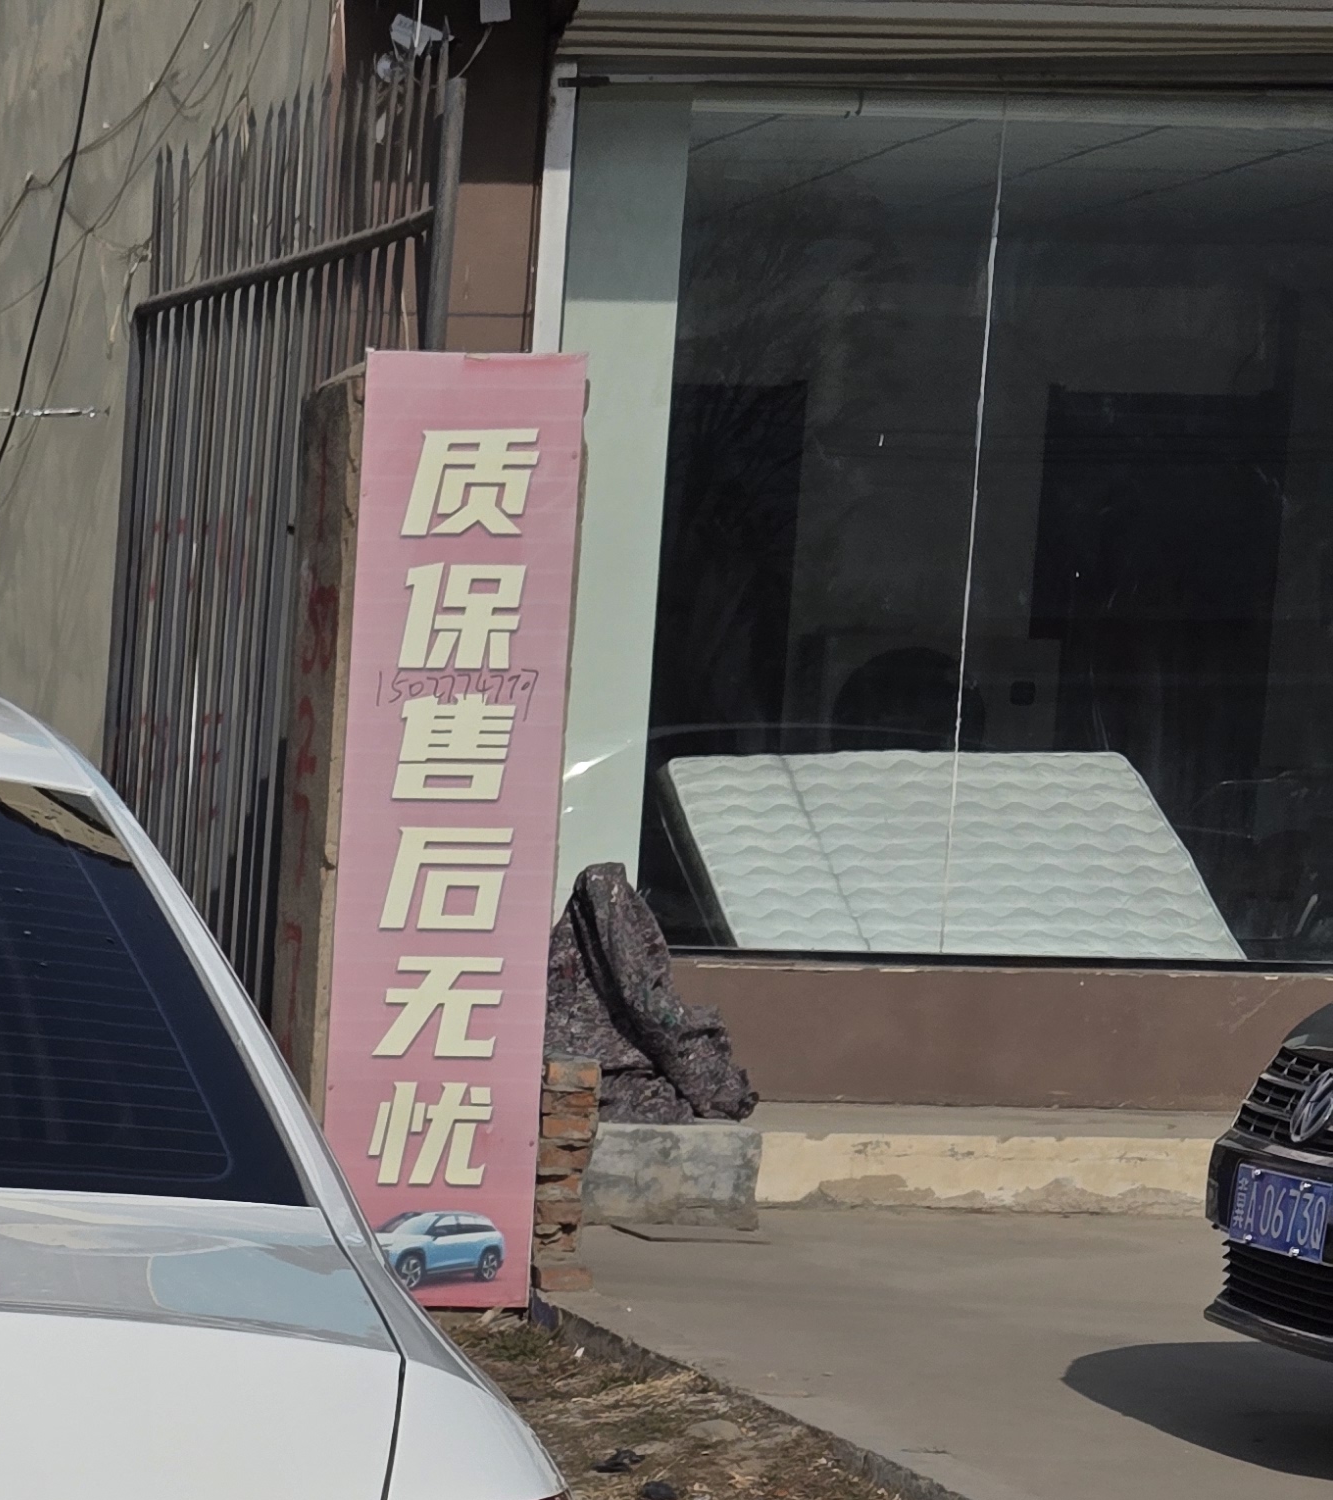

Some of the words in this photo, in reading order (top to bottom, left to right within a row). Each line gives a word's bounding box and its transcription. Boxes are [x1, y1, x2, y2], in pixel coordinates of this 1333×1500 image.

[368, 428, 540, 1185] 质保售后无忧
